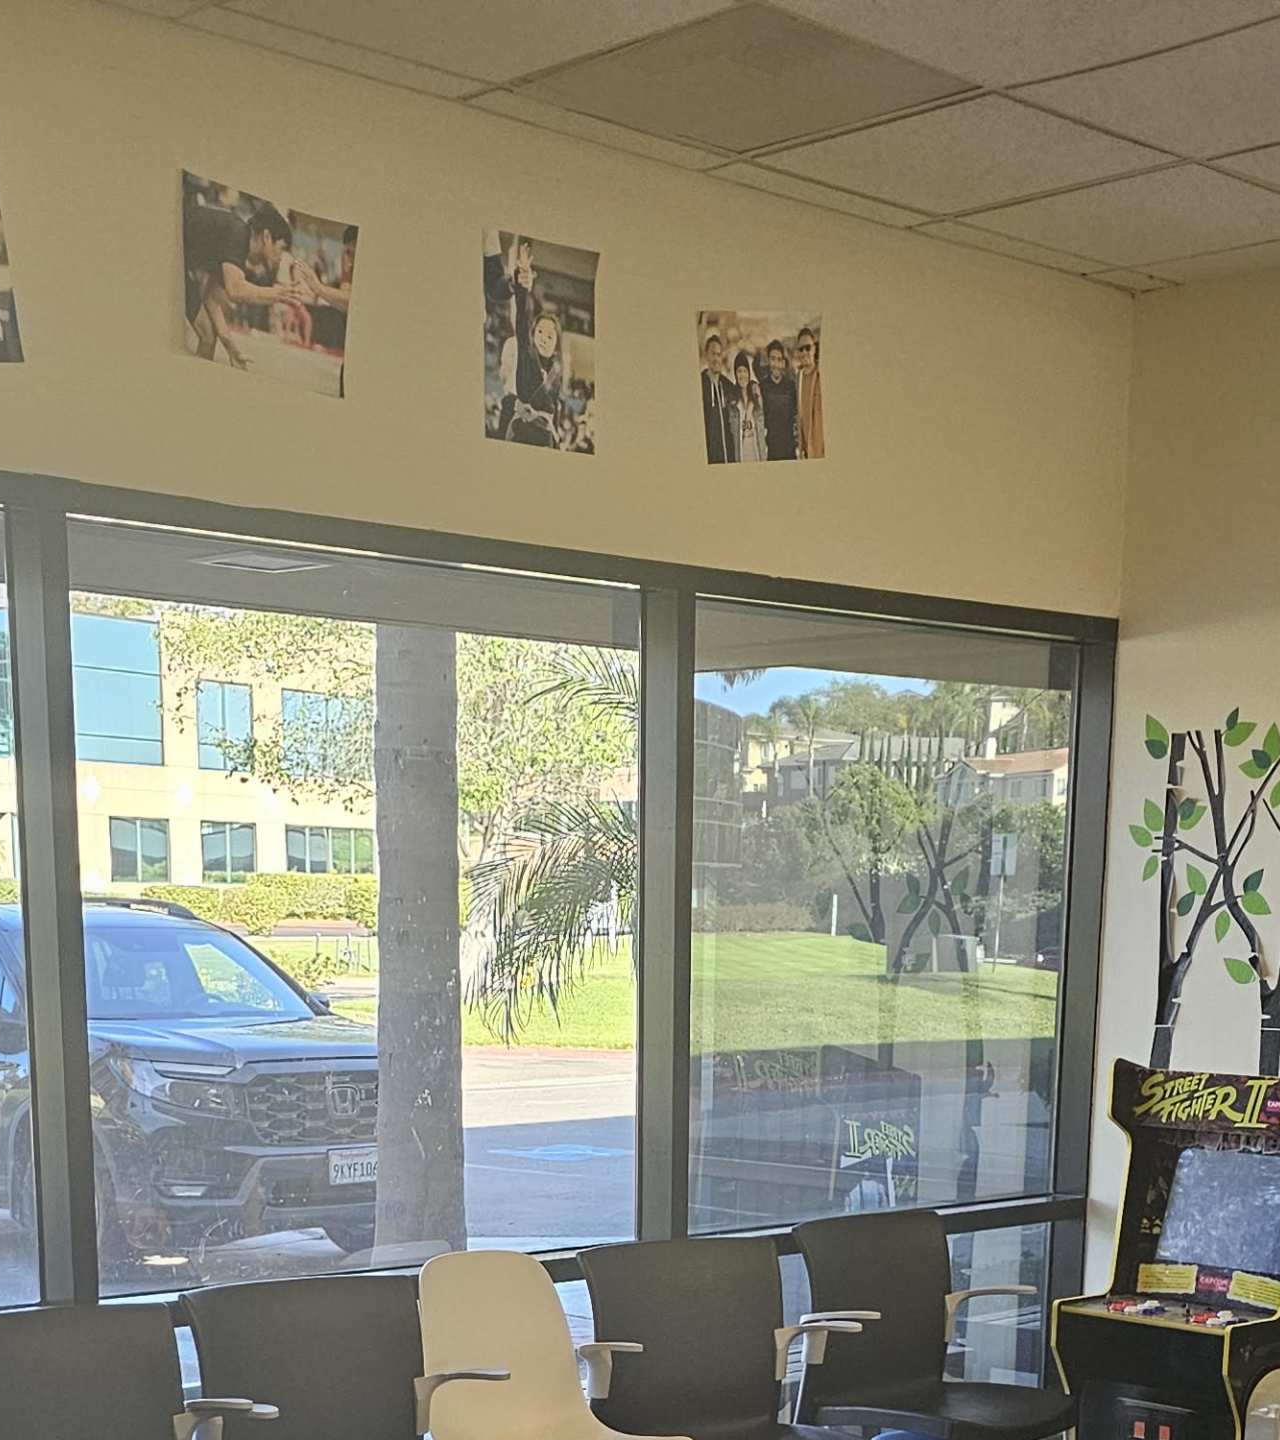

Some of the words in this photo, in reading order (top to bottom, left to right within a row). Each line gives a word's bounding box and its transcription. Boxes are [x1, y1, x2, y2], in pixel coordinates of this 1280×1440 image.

[1134, 1072, 1210, 1116] STREET
[1151, 1085, 1245, 1123] FIGHTER
[1233, 1079, 1279, 1128] II
